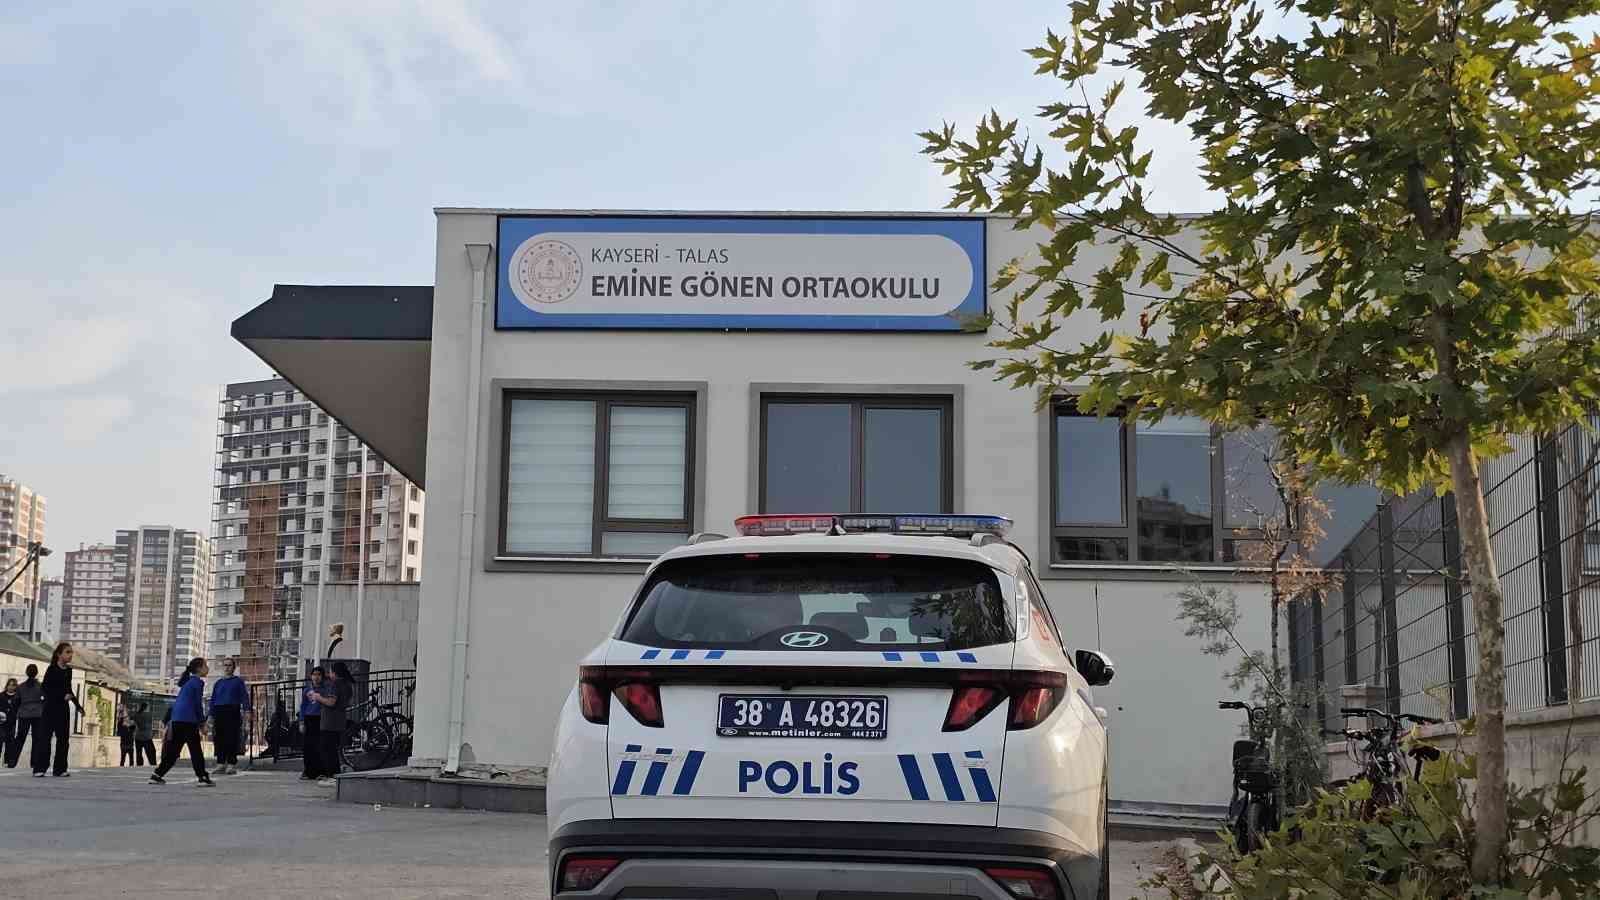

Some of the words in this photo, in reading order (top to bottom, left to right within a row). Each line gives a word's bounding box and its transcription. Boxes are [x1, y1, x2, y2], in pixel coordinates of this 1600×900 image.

[591, 243, 658, 263] KAYSERİ
[676, 248, 729, 264] TALAS
[591, 268, 672, 297] EMİNE
[681, 271, 773, 297] GÖNEN
[782, 276, 940, 299] ORTAOKULU
[733, 700, 763, 726] 38
[779, 700, 794, 726] A
[804, 701, 880, 727] 48326
[749, 728, 840, 737] www.metinler.com
[738, 752, 860, 795] POLİS
